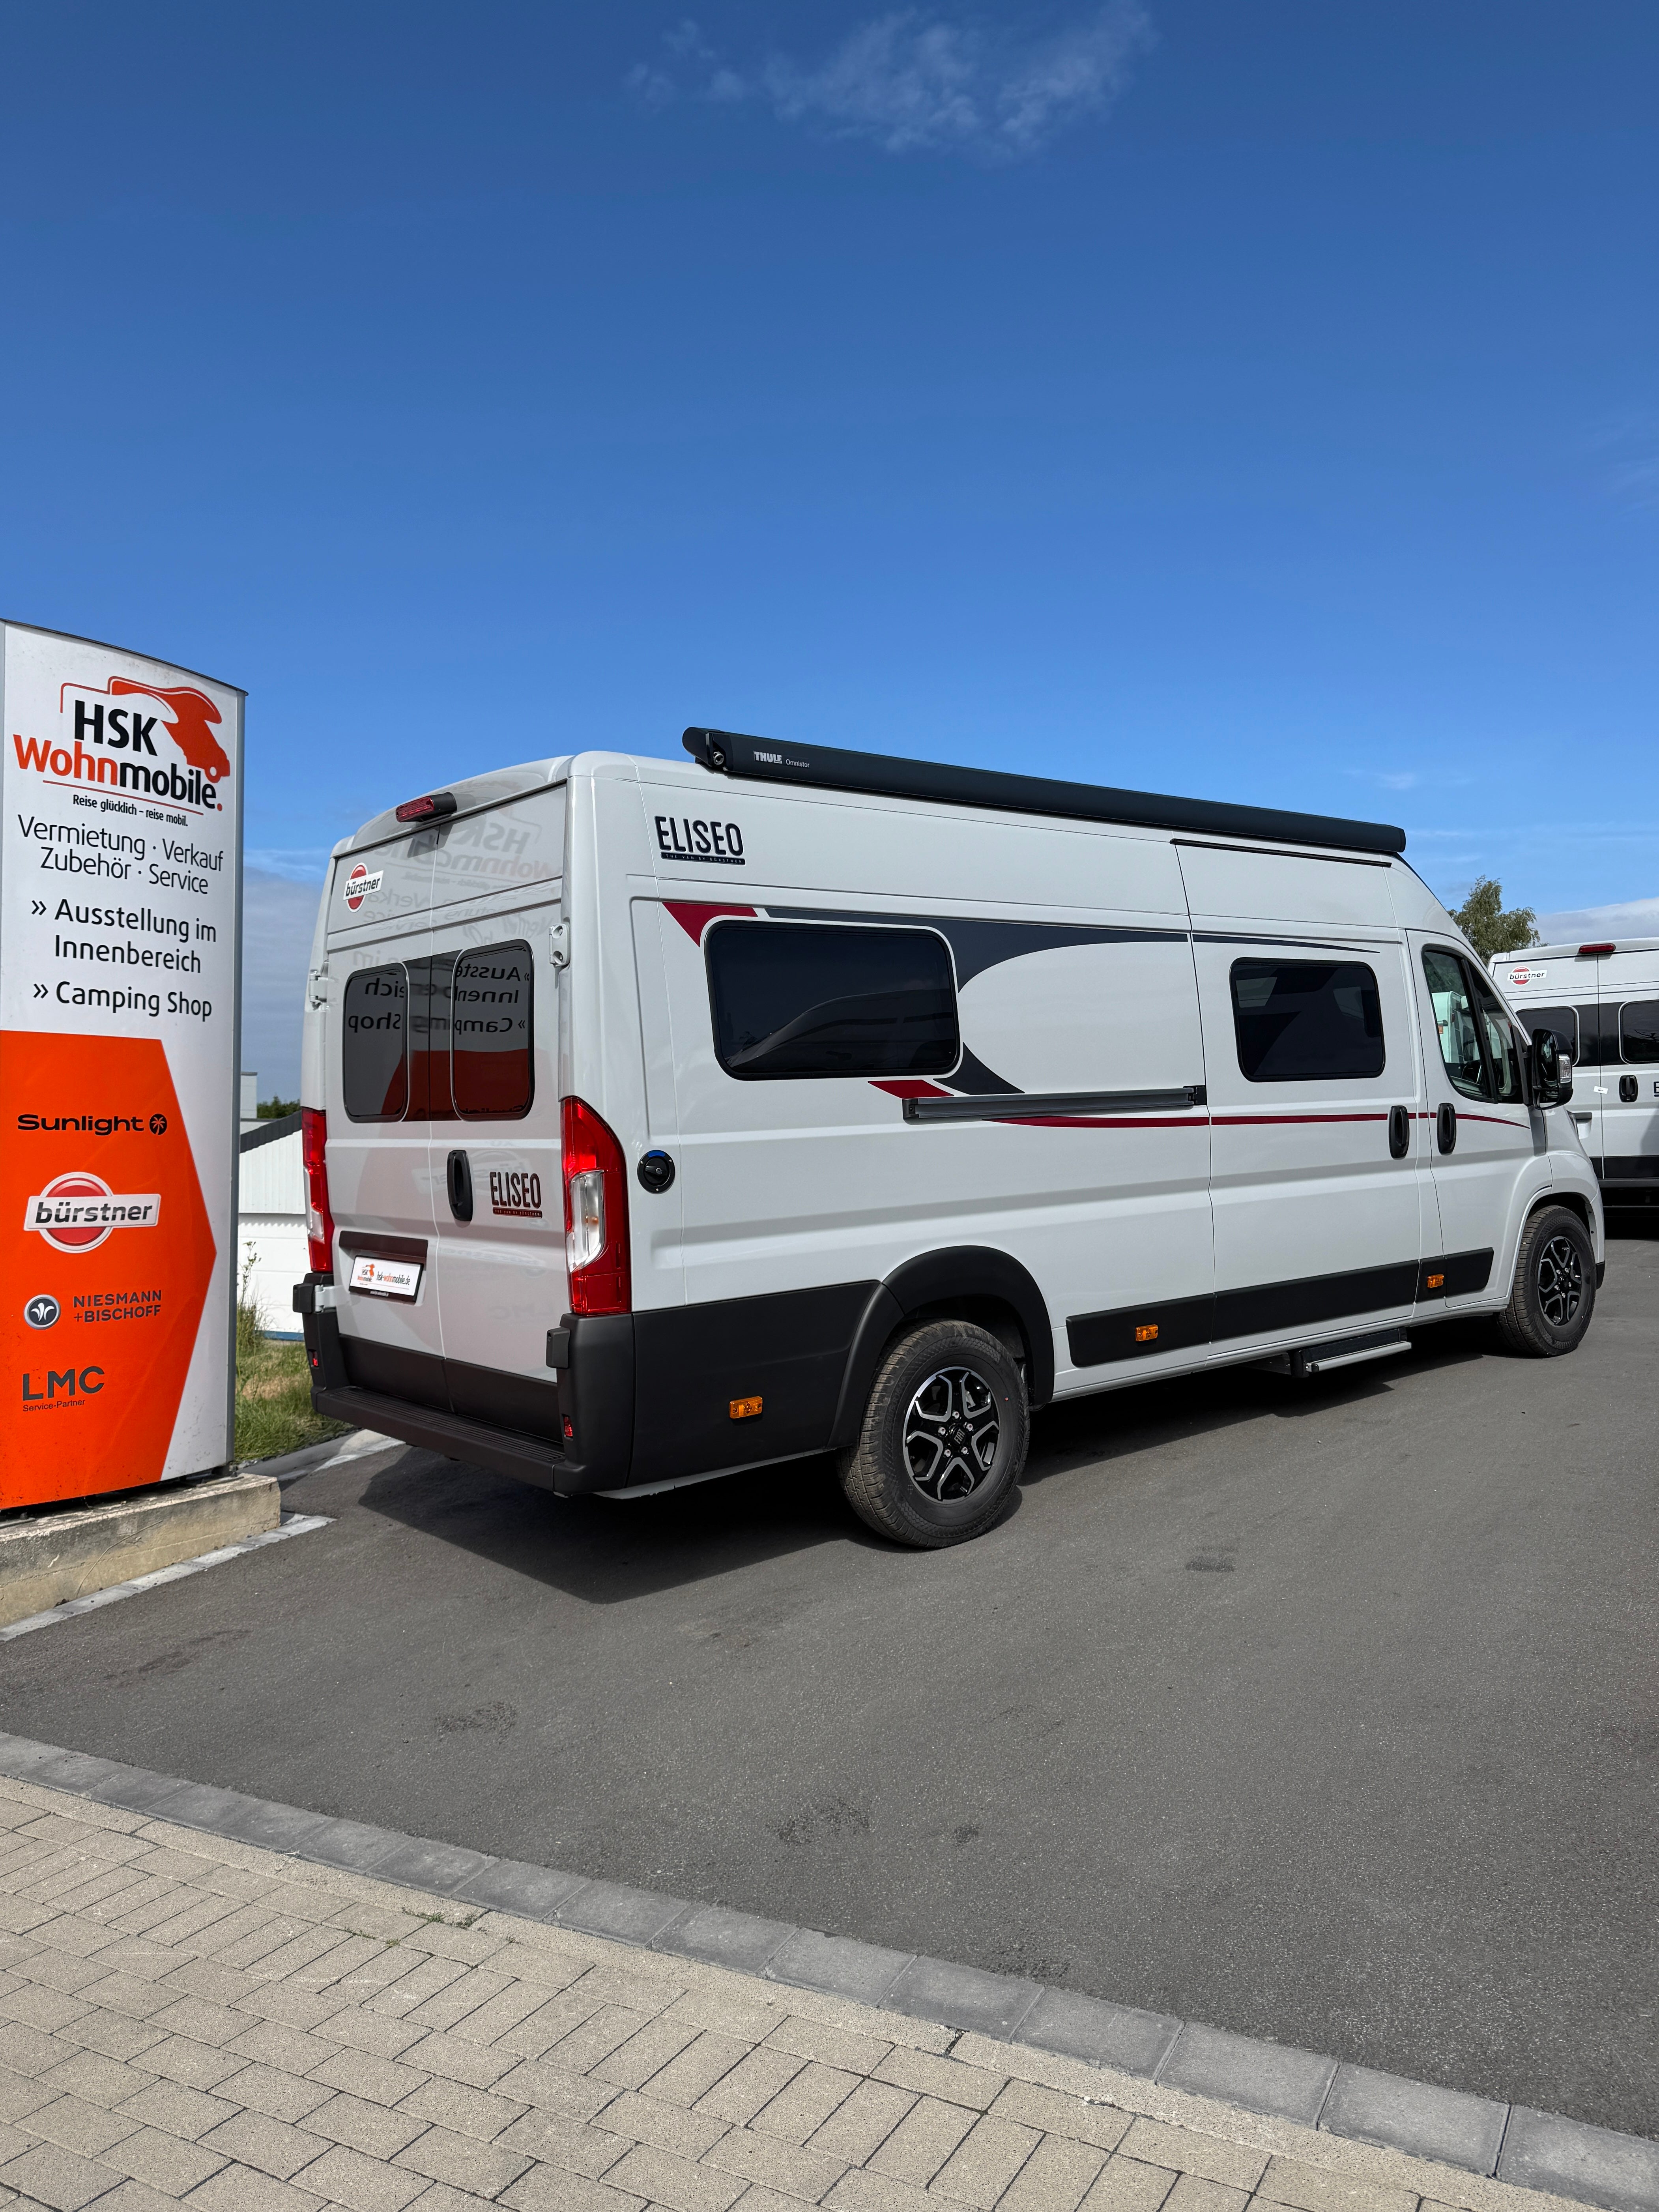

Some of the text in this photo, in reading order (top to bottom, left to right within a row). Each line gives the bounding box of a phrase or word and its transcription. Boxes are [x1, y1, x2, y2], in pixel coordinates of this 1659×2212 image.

[74, 700, 158, 756] HSK
[754, 751, 810, 768] THULE Omnistor
[73, 794, 97, 808] Reise
[100, 799, 137, 815] glücklich
[146, 808, 164, 821] reise
[166, 814, 188, 827] mobil.
[18, 814, 145, 860] Vermietung
[162, 838, 223, 871] Verkauf
[655, 816, 743, 857] ELISEO
[40, 847, 131, 880] Zubehör
[149, 863, 208, 895] Service
[346, 878, 380, 897] bürstner
[54, 899, 216, 943] Ausstellung im
[55, 935, 201, 973] Innenbereich
[56, 981, 212, 1022] Camping Shop
[18, 1114, 144, 1136] Sunlight
[490, 1171, 541, 1209] ELISEO
[35, 1202, 153, 1223] bürstner
[73, 1290, 161, 1308] NIESMANN
[73, 1304, 161, 1323] +BISCHOFF
[23, 1366, 105, 1401] LMC
[23, 1400, 86, 1412] Service-Partner
[954, 1428, 965, 1444] FIAT
